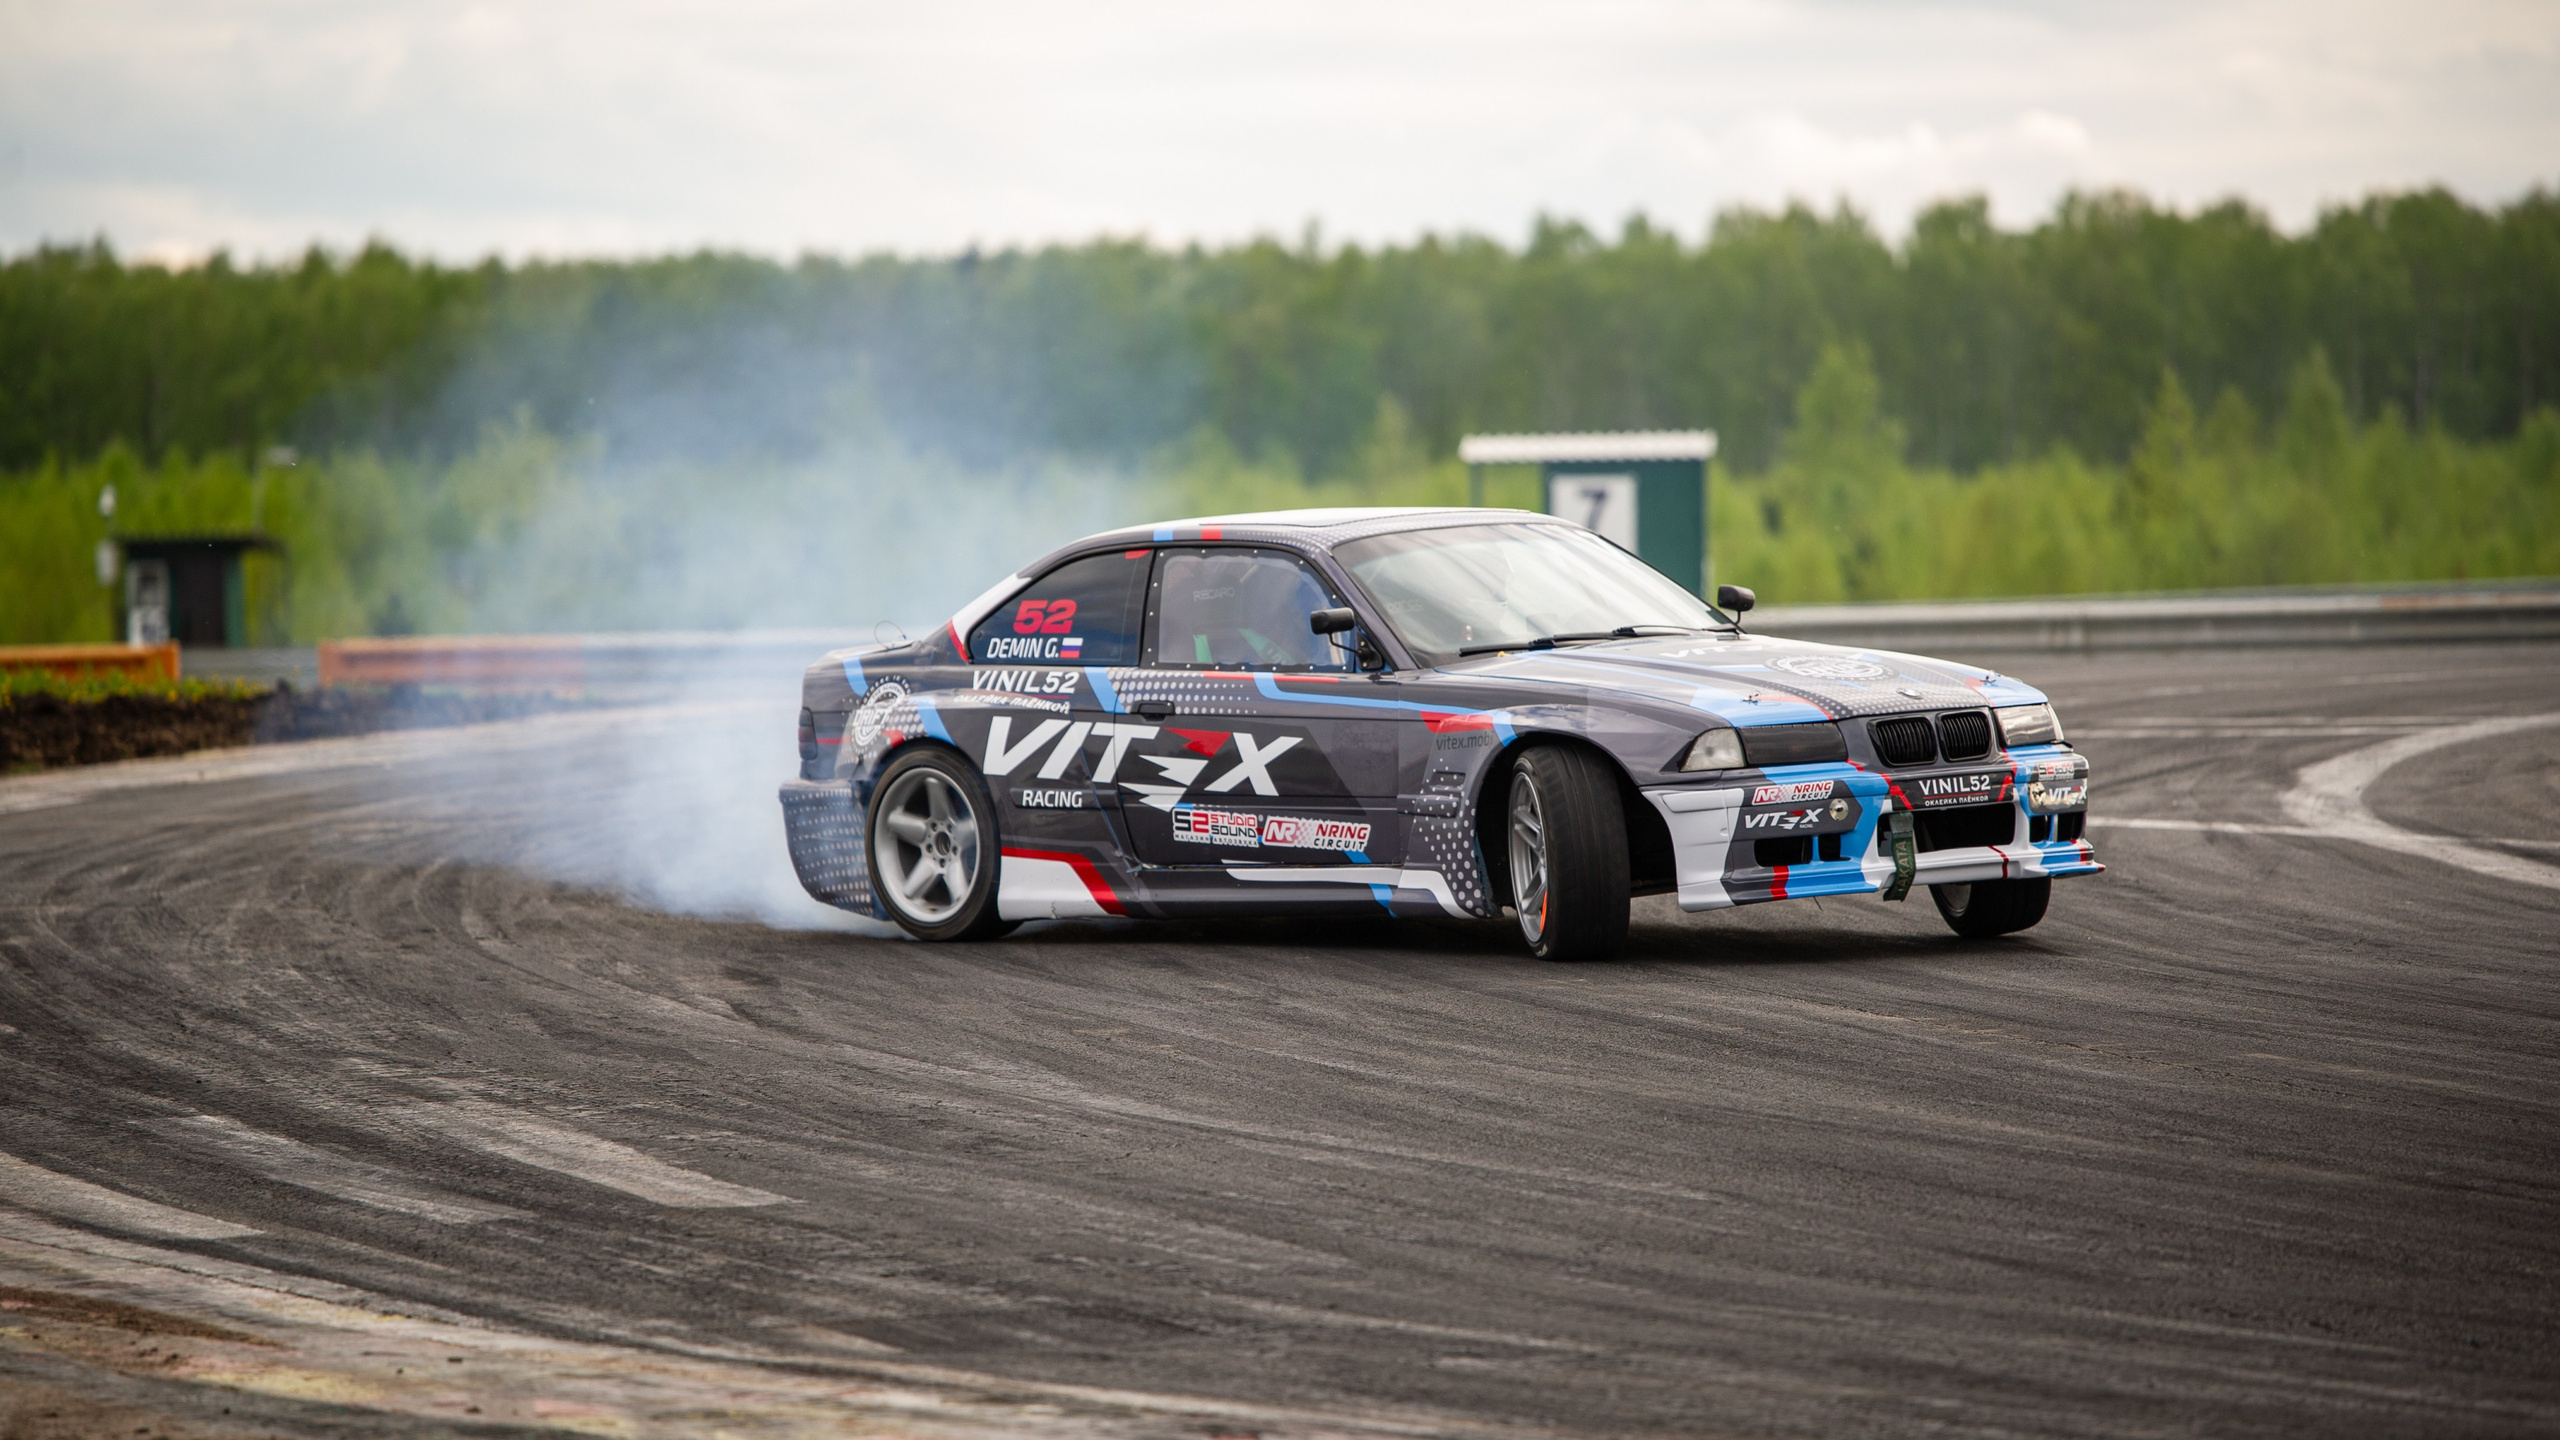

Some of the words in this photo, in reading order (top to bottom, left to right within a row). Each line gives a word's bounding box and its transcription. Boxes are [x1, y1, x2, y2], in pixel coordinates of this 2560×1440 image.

[1579, 488, 1608, 531] 7
[1012, 598, 1078, 634] 52
[986, 637, 1044, 659] DEMIN
[1044, 637, 1060, 659] G.
[972, 669, 1081, 695] VINIL52
[953, 694, 1007, 705] ОКЛЕЙКА
[1009, 696, 1072, 715] ПЛЁНКОЙ
[852, 708, 893, 727] DRIFT
[1436, 730, 1495, 751] vitex.mobi
[1793, 781, 1832, 794] NRING
[1918, 775, 1991, 796] VINIL52
[1022, 789, 1083, 809] RACING
[1756, 788, 1780, 803] NR
[1791, 791, 1830, 801] CIRCUIT
[1924, 797, 1958, 807] ОКЛЕЙКА
[1958, 795, 1989, 804] ПЛЁНКОЙ
[1174, 810, 1210, 834] S2
[1210, 813, 1257, 827] STUDIO
[1174, 833, 1210, 842] МАГАЗИН
[1213, 837, 1258, 846] АВТОЗВУКА
[1211, 824, 1257, 838] SOUND
[1266, 820, 1297, 842] NR
[1315, 823, 1368, 840] NRING
[1313, 838, 1366, 851] CIRCUIT
